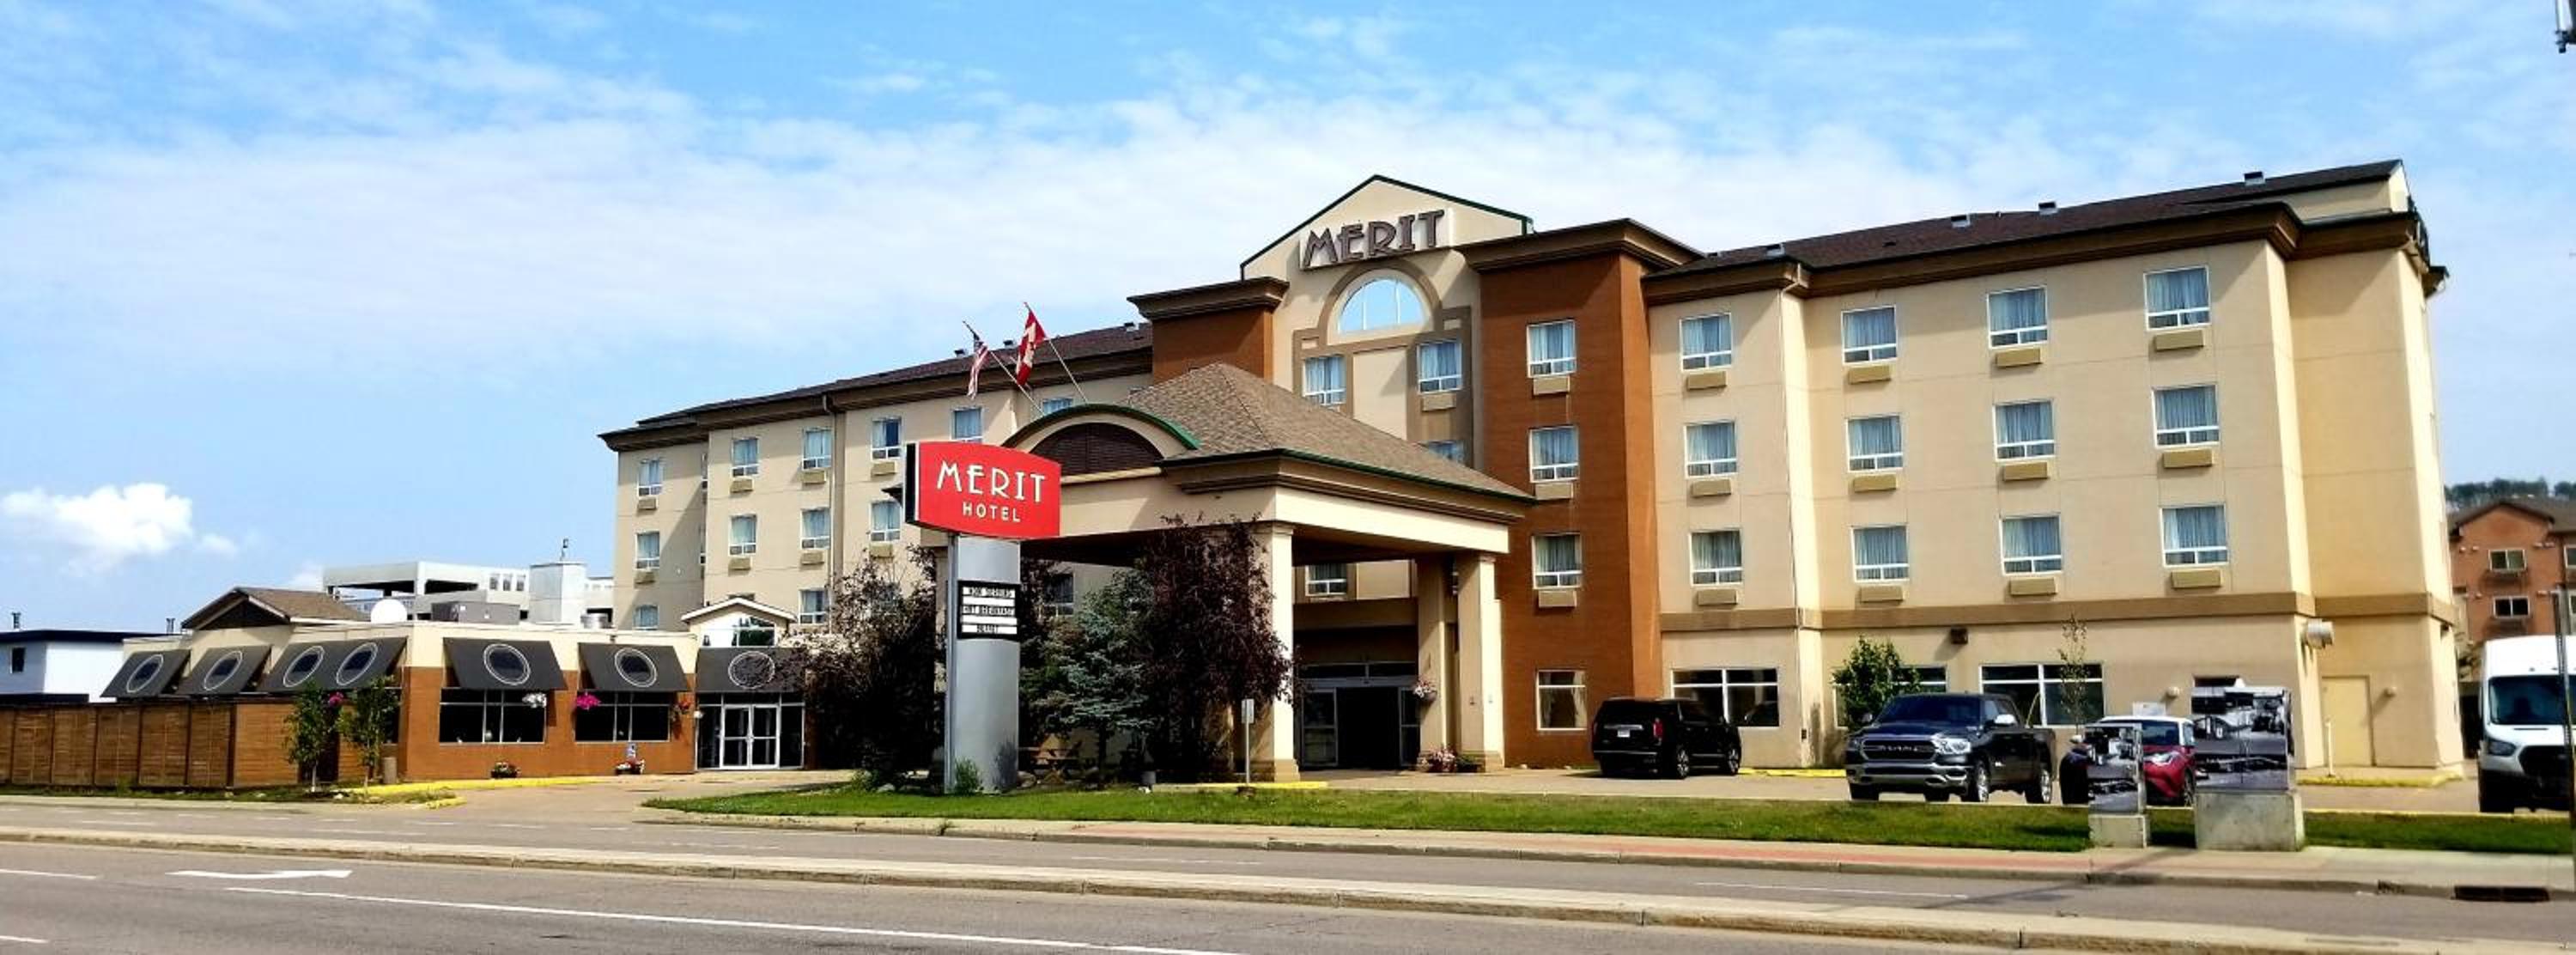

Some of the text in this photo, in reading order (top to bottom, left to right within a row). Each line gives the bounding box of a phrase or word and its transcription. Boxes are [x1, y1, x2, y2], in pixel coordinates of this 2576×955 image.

[1303, 210, 1444, 267] MERIT
[937, 460, 1046, 502] MERIT
[963, 502, 1021, 522] HOTEL
